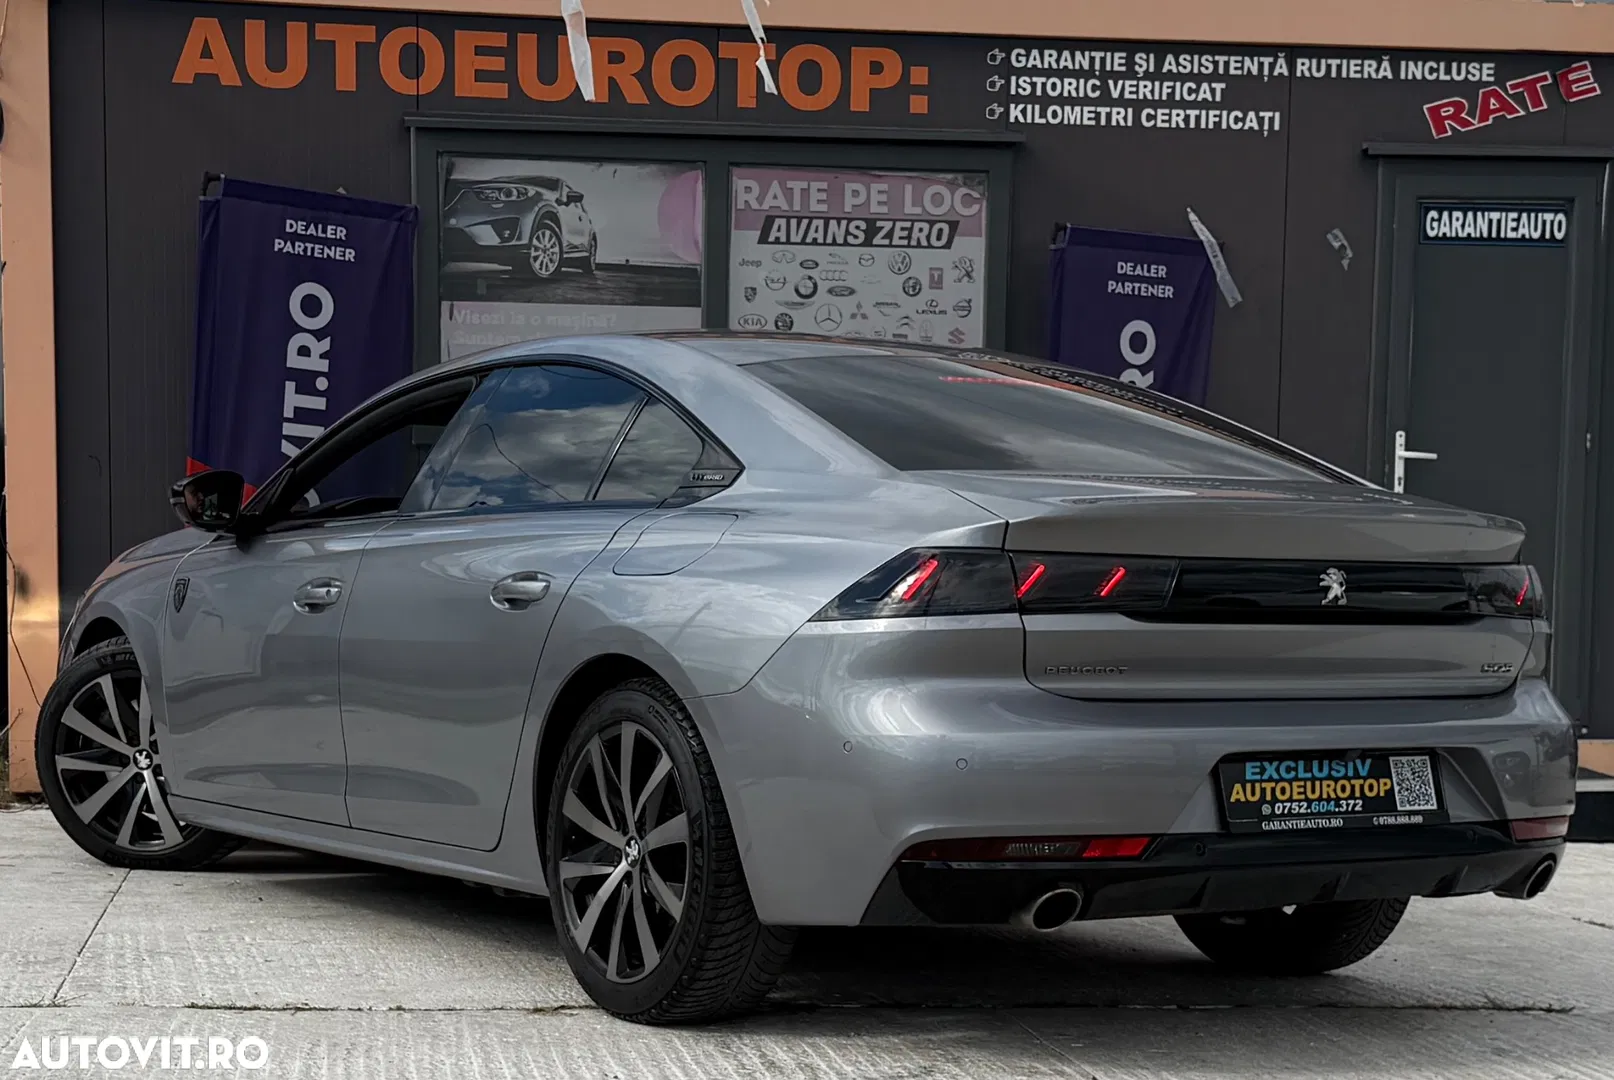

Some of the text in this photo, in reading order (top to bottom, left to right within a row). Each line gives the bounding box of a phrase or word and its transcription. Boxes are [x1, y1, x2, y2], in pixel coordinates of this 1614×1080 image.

[171, 16, 929, 114] AUTOEUROTOP:
[1161, 53, 1290, 82] ASISTENȚĂ
[1295, 55, 1394, 80] RUTIERĂ
[1399, 60, 1496, 82] INCLUSE
[1009, 75, 1227, 103] ISTORIC VERIFICAT
[1423, 60, 1601, 139] RATE
[1008, 103, 1134, 127] KILOMETRI
[736, 178, 982, 217] RATE PE LOC
[285, 218, 347, 241] DEALER
[767, 217, 950, 248] AVANS ZERO
[1425, 210, 1567, 240] GARANTIEAUTO
[273, 238, 356, 263] PARTENER
[738, 257, 762, 268] Jeep
[1117, 261, 1168, 279] DEALER
[1107, 280, 1174, 299] PARTENER
[743, 317, 764, 327] KIA
[1044, 665, 1129, 676] PEUGEOT
[1245, 758, 1372, 780] EXCLUSIV
[1230, 778, 1392, 802] AUTOEUROTOP
[1274, 799, 1363, 815] 0752.604.372
[1261, 817, 1344, 831] GARANTIEAUTO.RO
